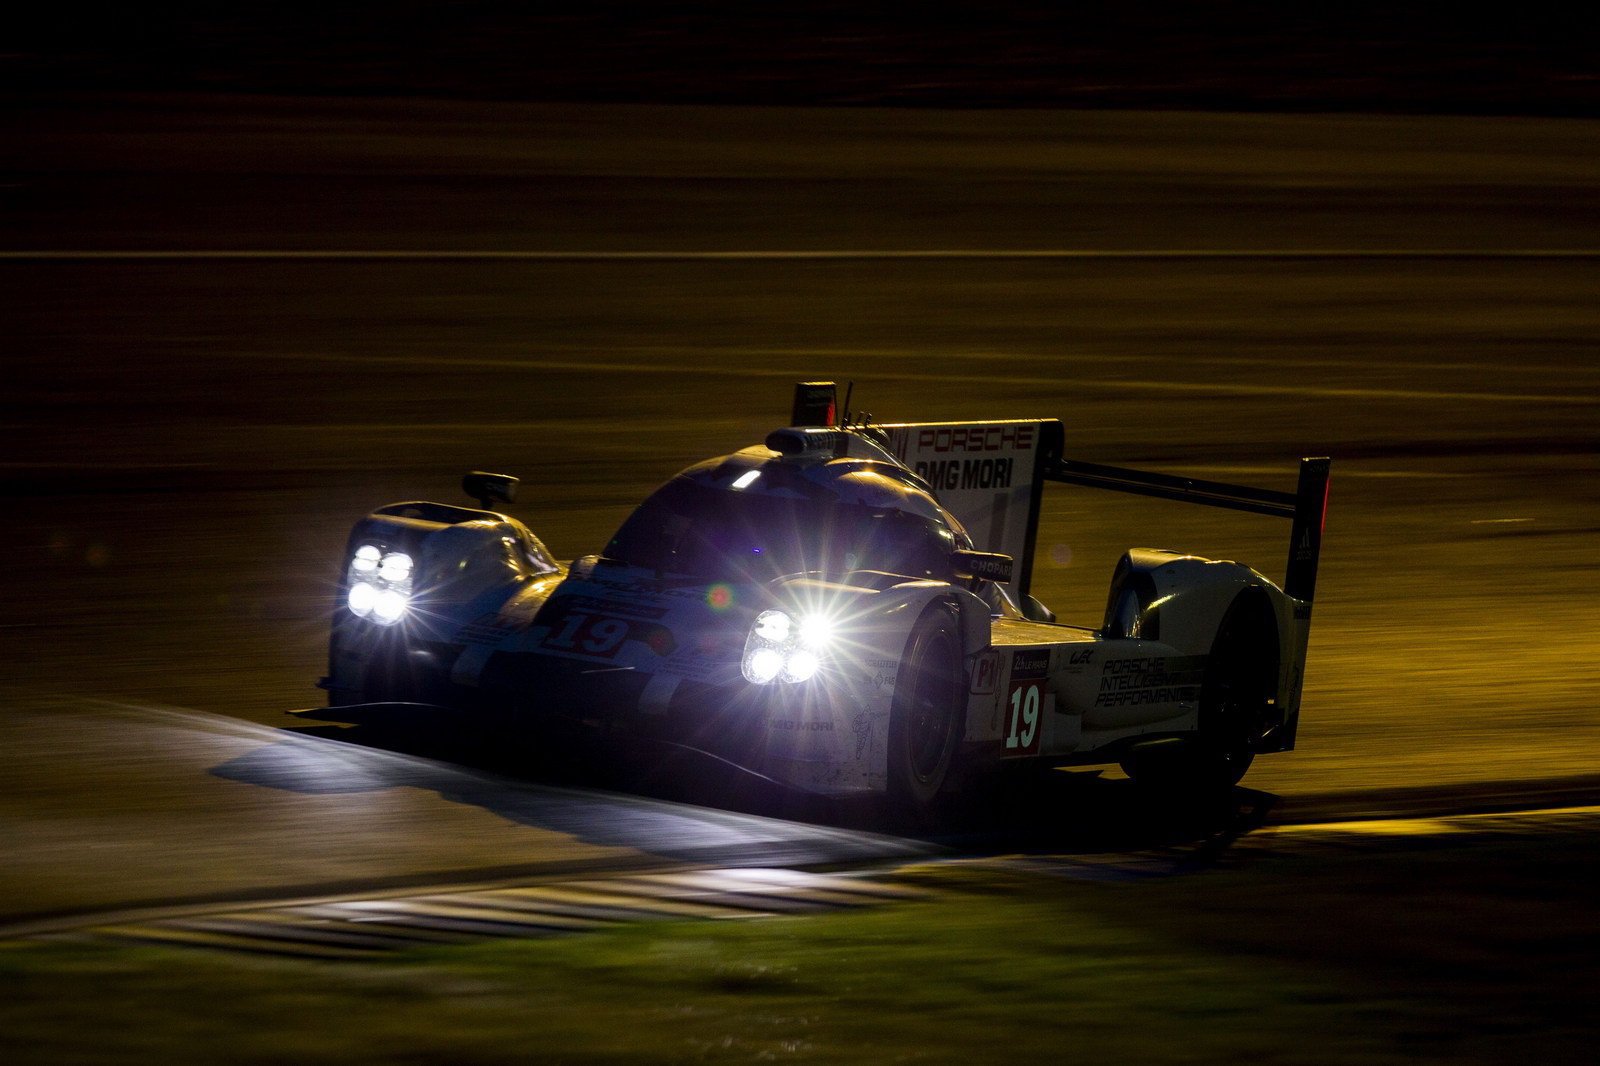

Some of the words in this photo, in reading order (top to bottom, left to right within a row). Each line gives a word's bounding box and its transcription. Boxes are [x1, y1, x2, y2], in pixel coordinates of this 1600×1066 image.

[919, 427, 1034, 452] PORSCHE
[962, 458, 1013, 490] MORI
[547, 614, 630, 652] 19
[1103, 657, 1165, 675] PORSCHE
[1100, 672, 1182, 691] INTELLIGENT
[1006, 685, 1039, 749] 19
